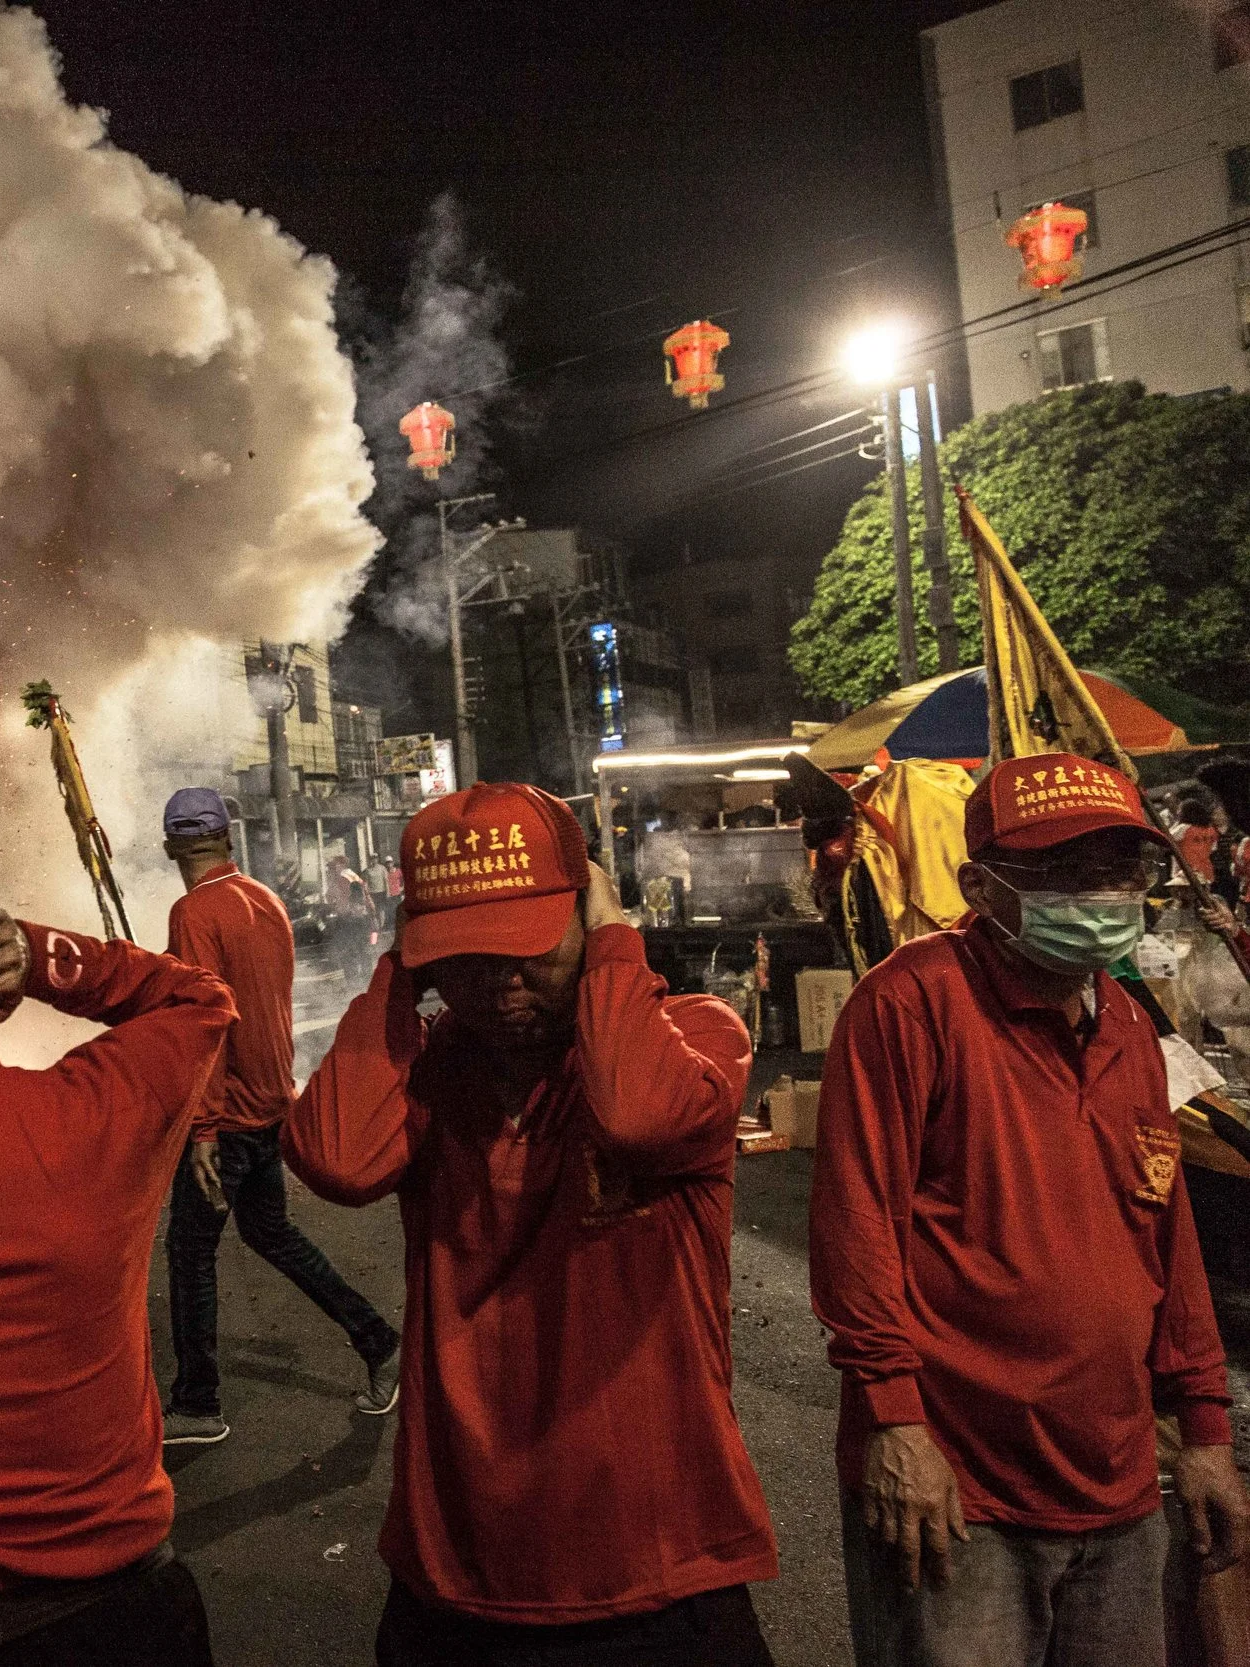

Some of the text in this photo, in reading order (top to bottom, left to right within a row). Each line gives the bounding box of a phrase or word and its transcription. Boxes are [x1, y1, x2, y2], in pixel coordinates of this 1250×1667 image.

[1014, 765, 1118, 791] 大甲五十三庄
[414, 823, 527, 861] 大甲五十三庄
